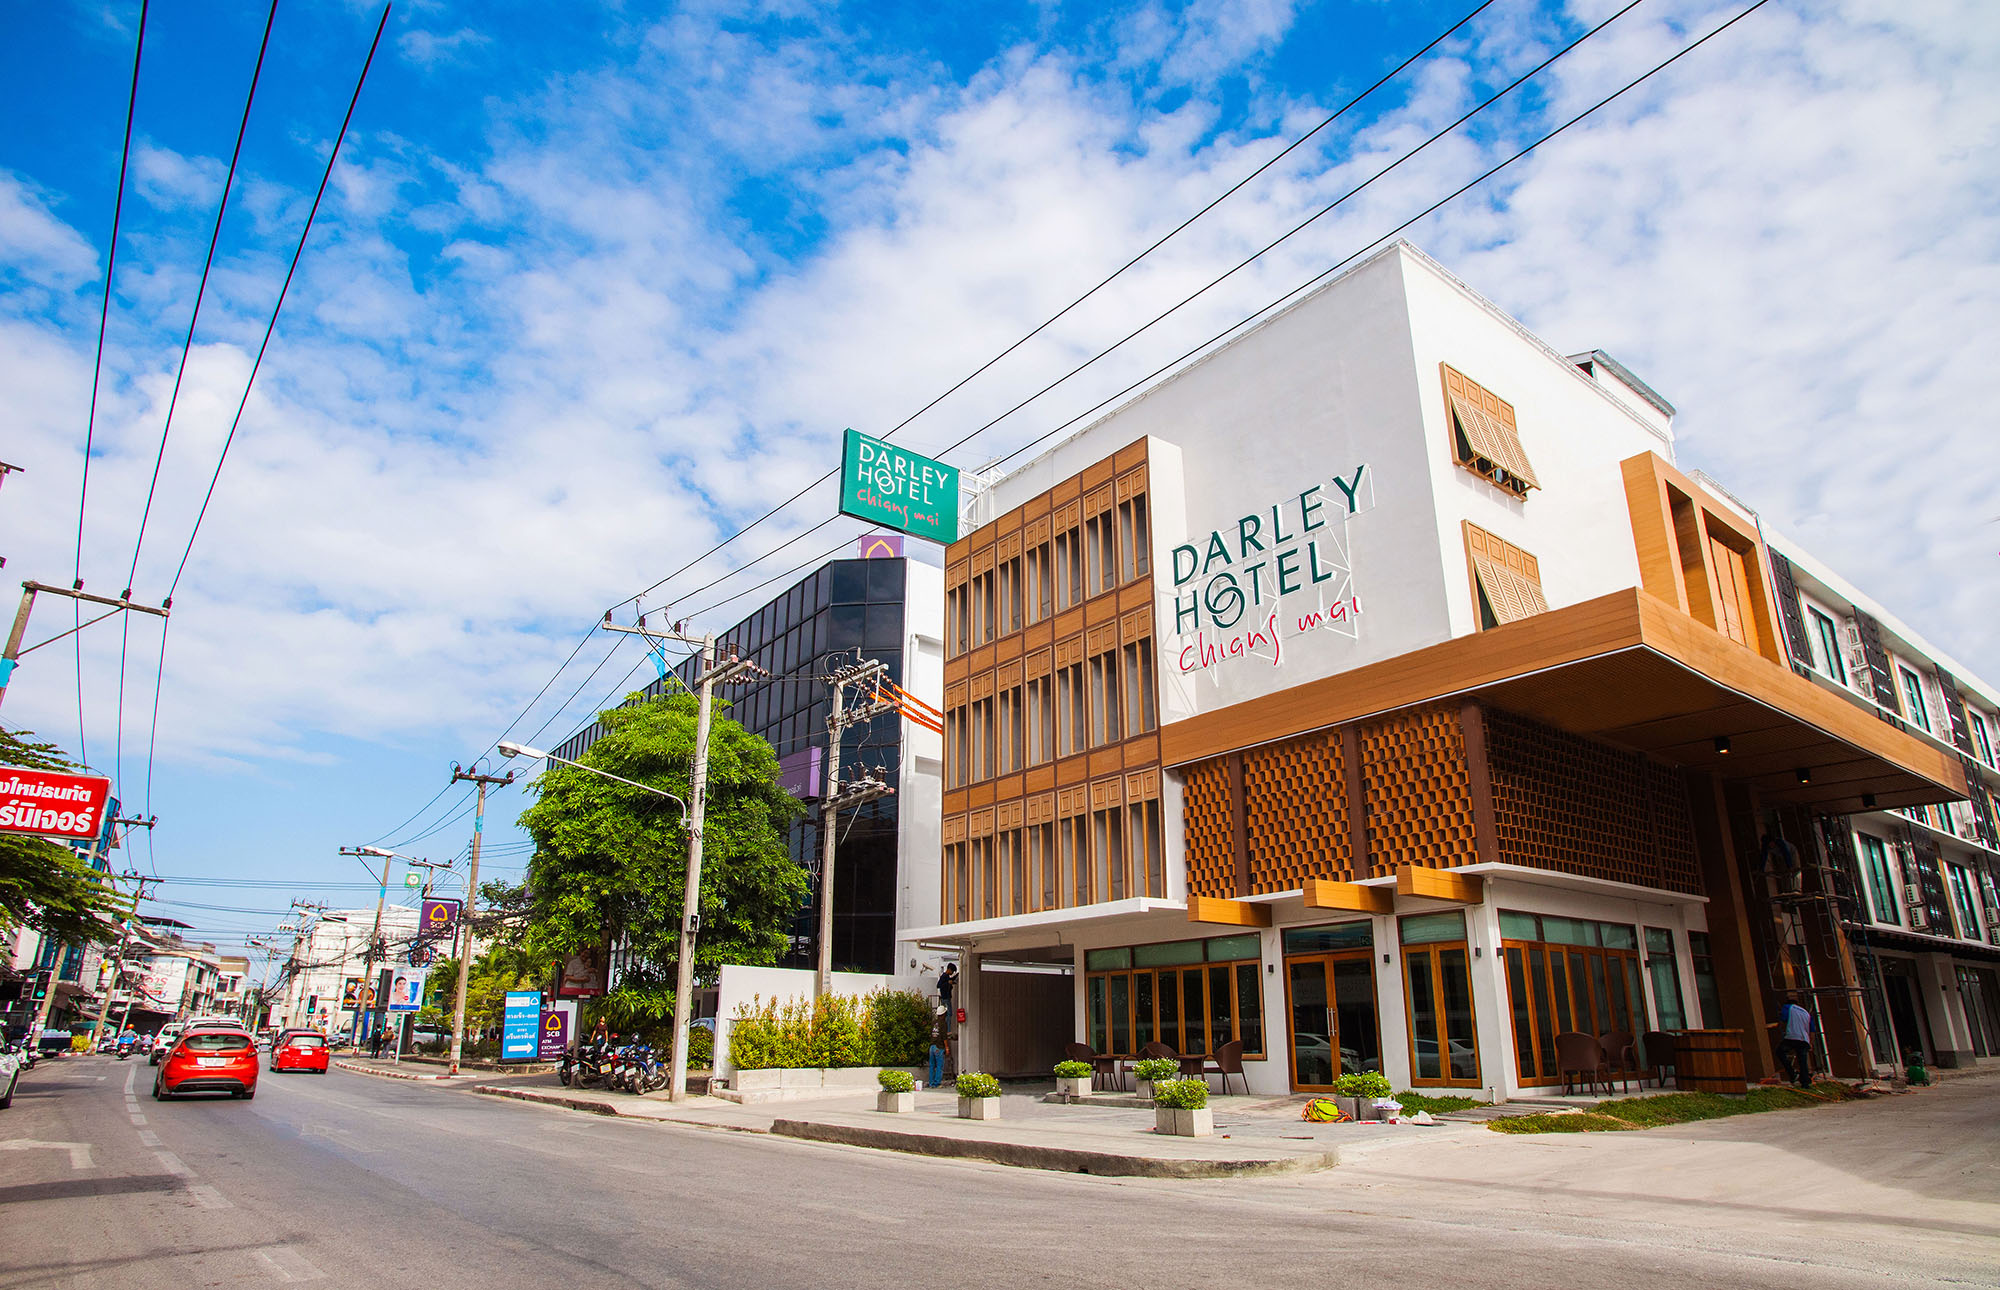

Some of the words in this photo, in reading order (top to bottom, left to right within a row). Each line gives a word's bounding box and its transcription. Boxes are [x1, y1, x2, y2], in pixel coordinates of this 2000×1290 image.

[858, 462, 933, 505] HOTEL
[859, 442, 949, 489] DARLEY
[914, 512, 939, 526] mai
[1171, 464, 1365, 587] DARLEY
[1174, 540, 1334, 636] HOTEL
[1298, 596, 1360, 631] mai
[546, 1030, 560, 1038] SCB
